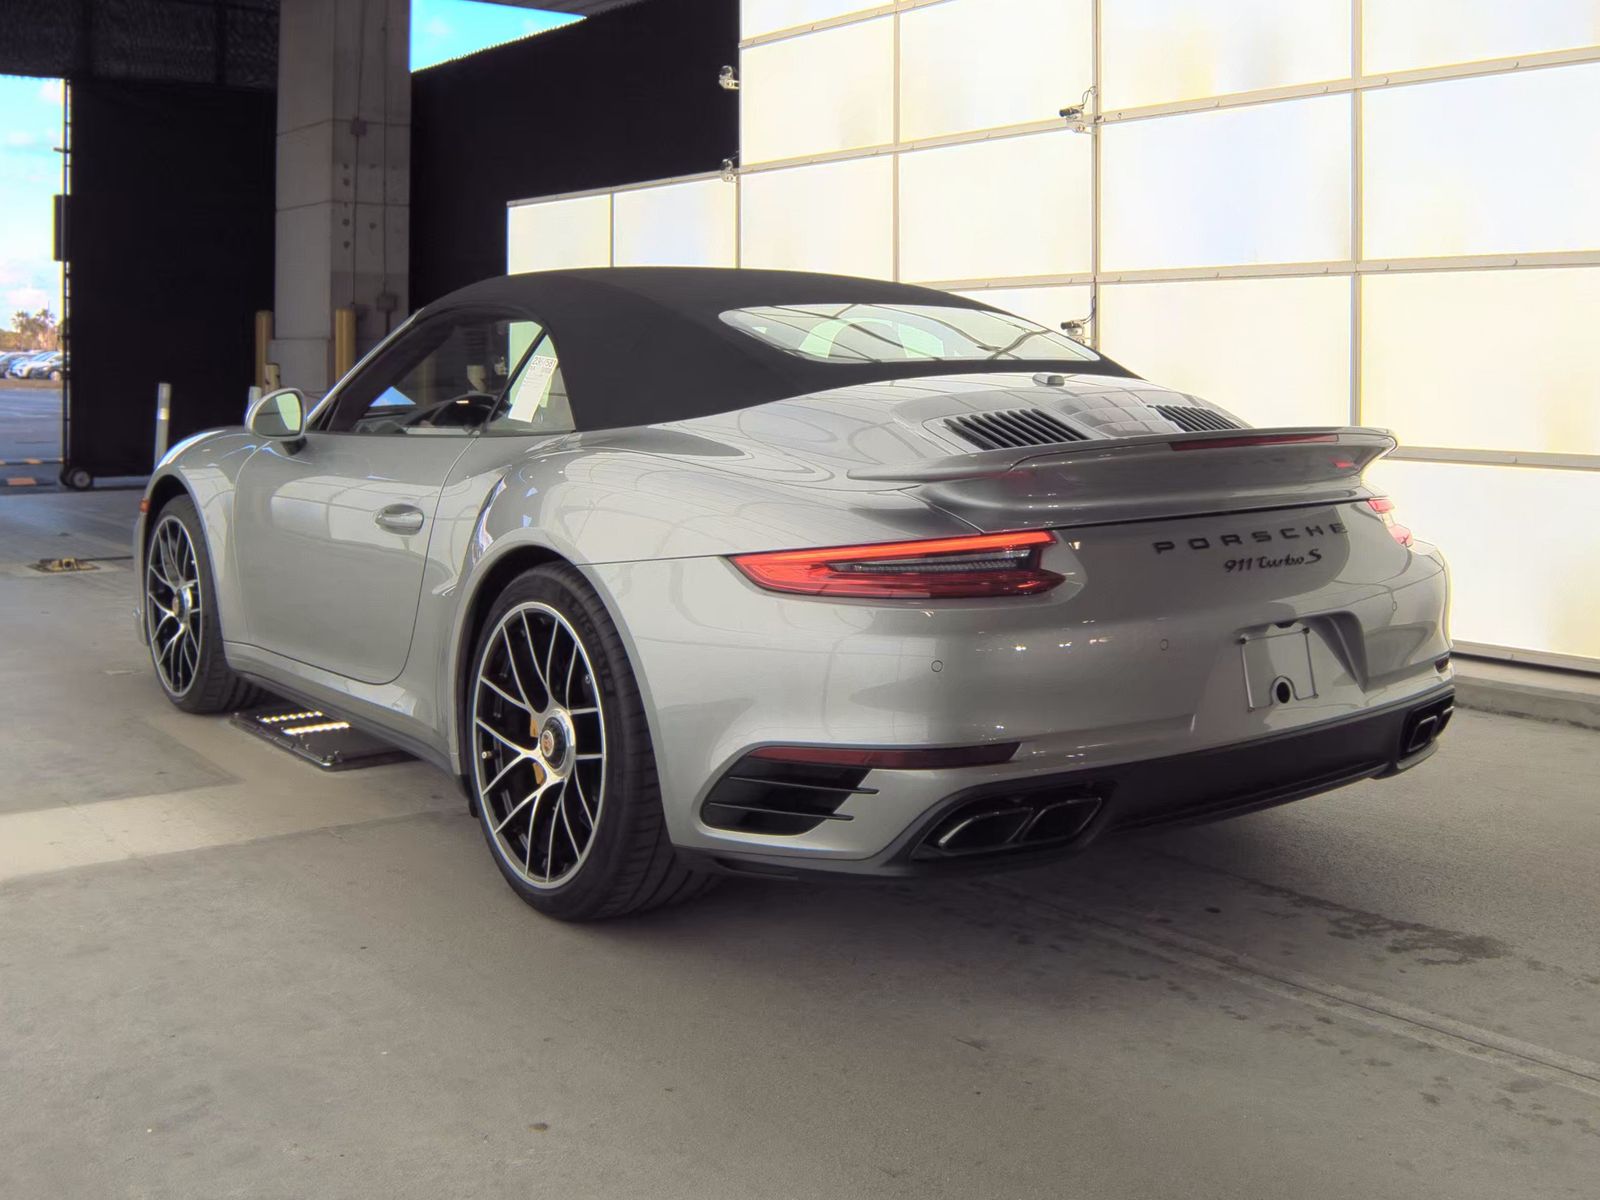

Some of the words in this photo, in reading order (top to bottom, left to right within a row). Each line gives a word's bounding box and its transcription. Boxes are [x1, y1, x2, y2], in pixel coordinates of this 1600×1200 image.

[1153, 522, 1348, 554] PORSCHE
[1224, 557, 1253, 573] 911
[1256, 553, 1304, 570] Turbo
[1304, 548, 1322, 565] S
